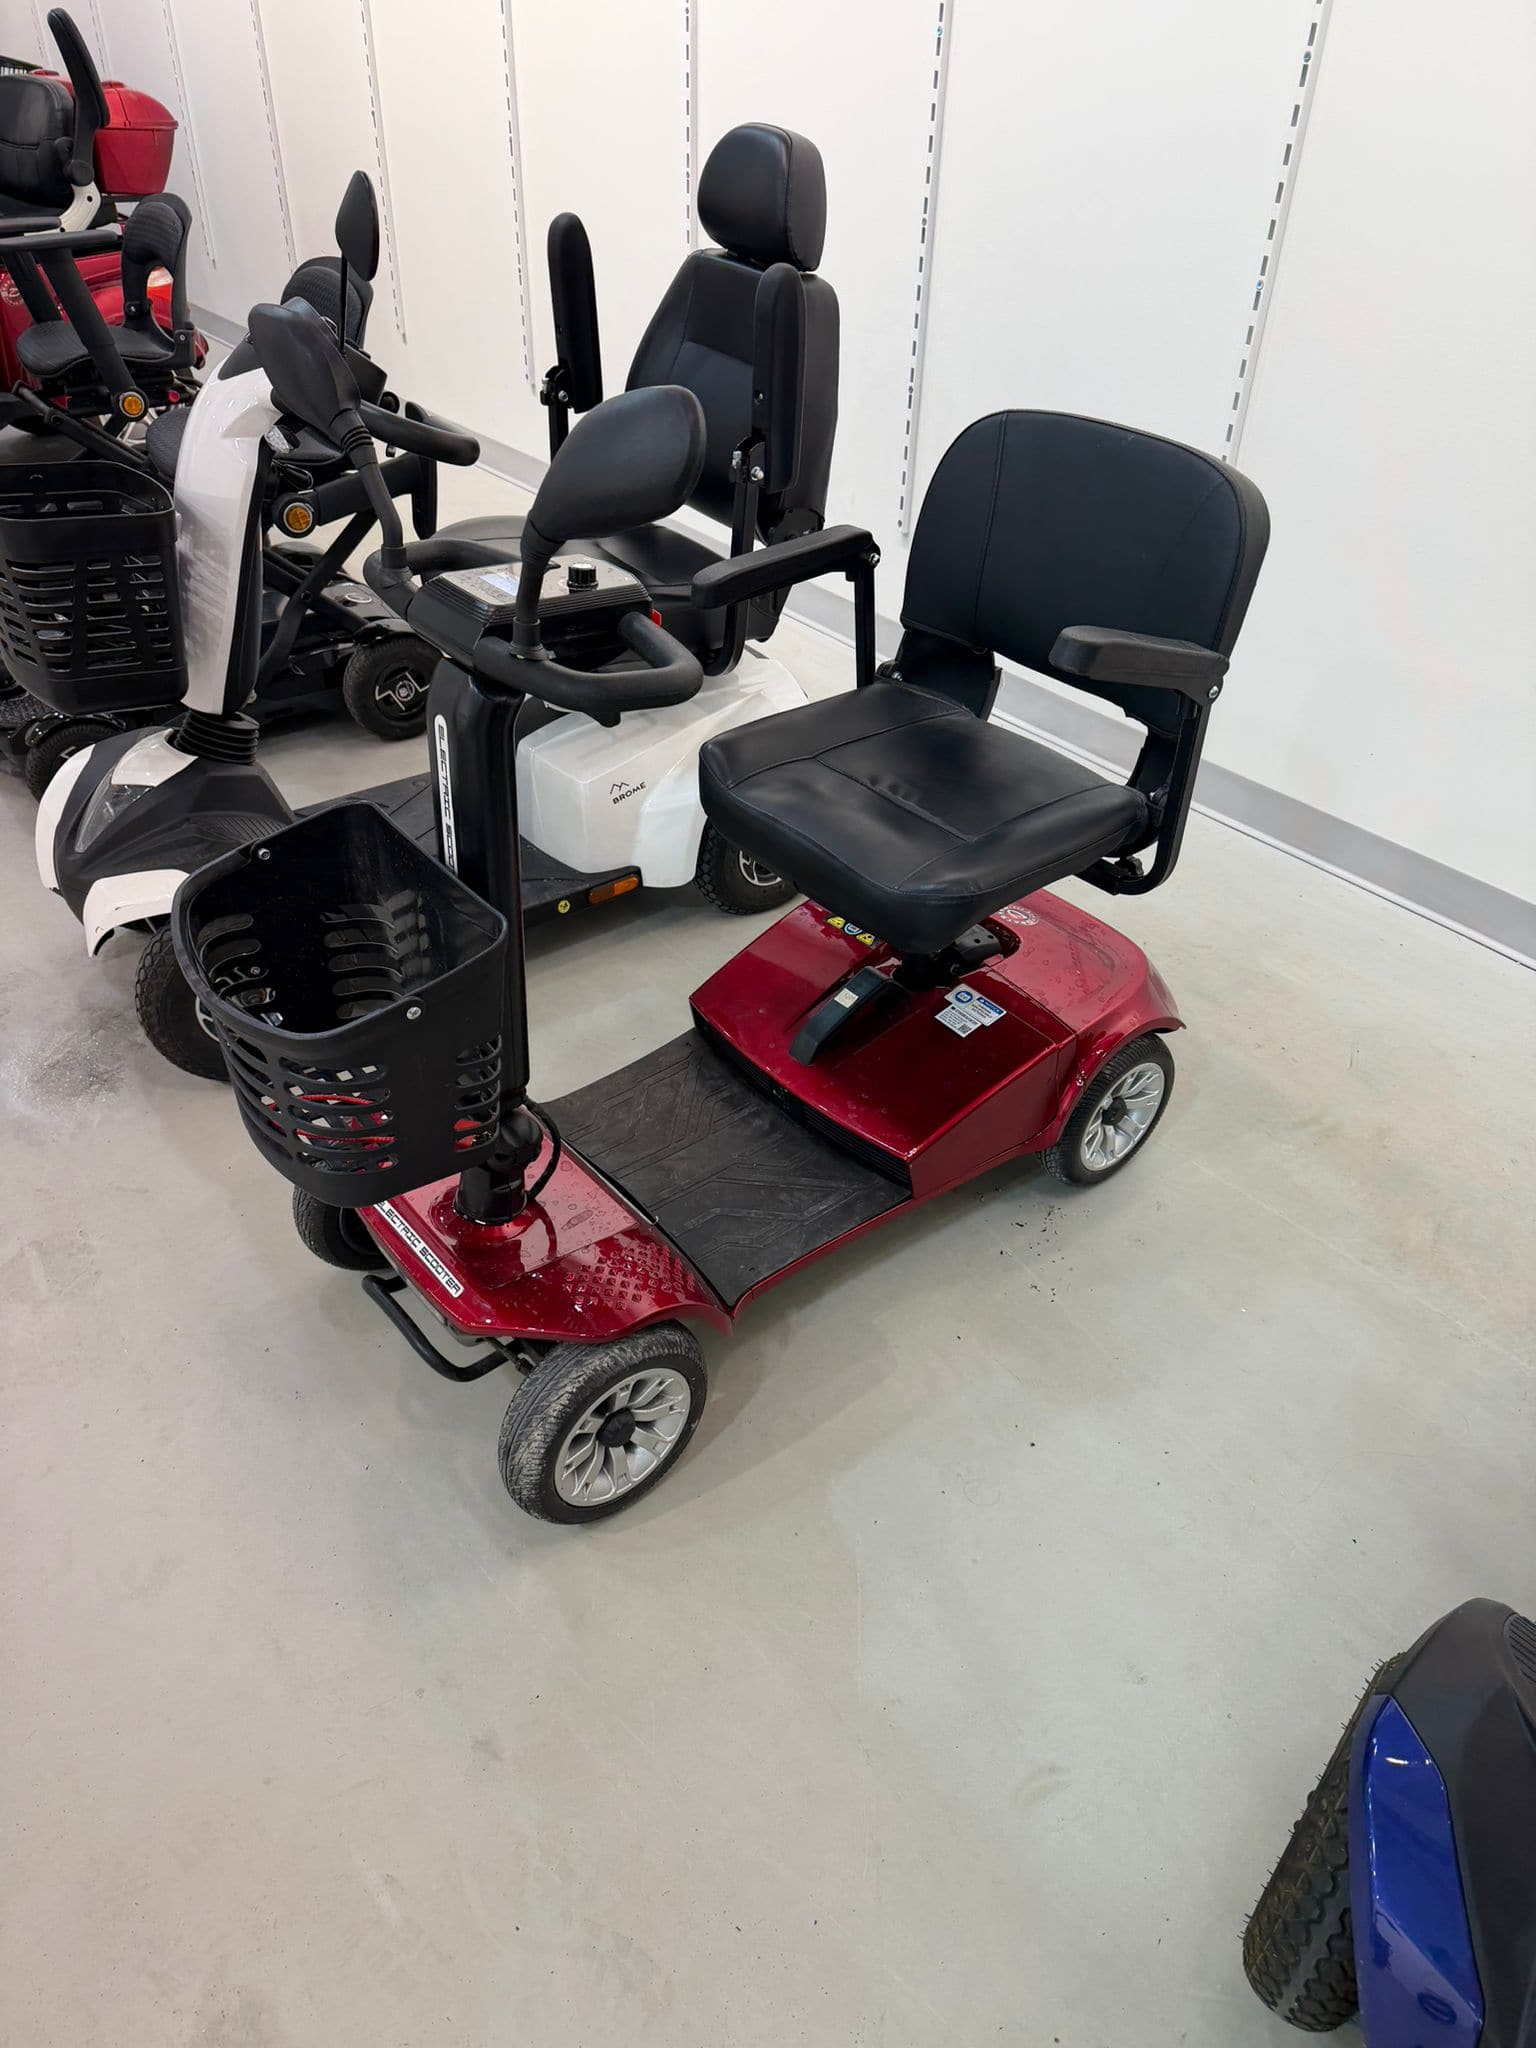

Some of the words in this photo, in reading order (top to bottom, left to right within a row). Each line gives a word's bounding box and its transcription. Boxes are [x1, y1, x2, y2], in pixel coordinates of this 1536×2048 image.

[439, 724, 451, 820] ELECTRIC
[612, 781, 646, 805] BROME
[419, 1246, 461, 1295] SCOOTER
